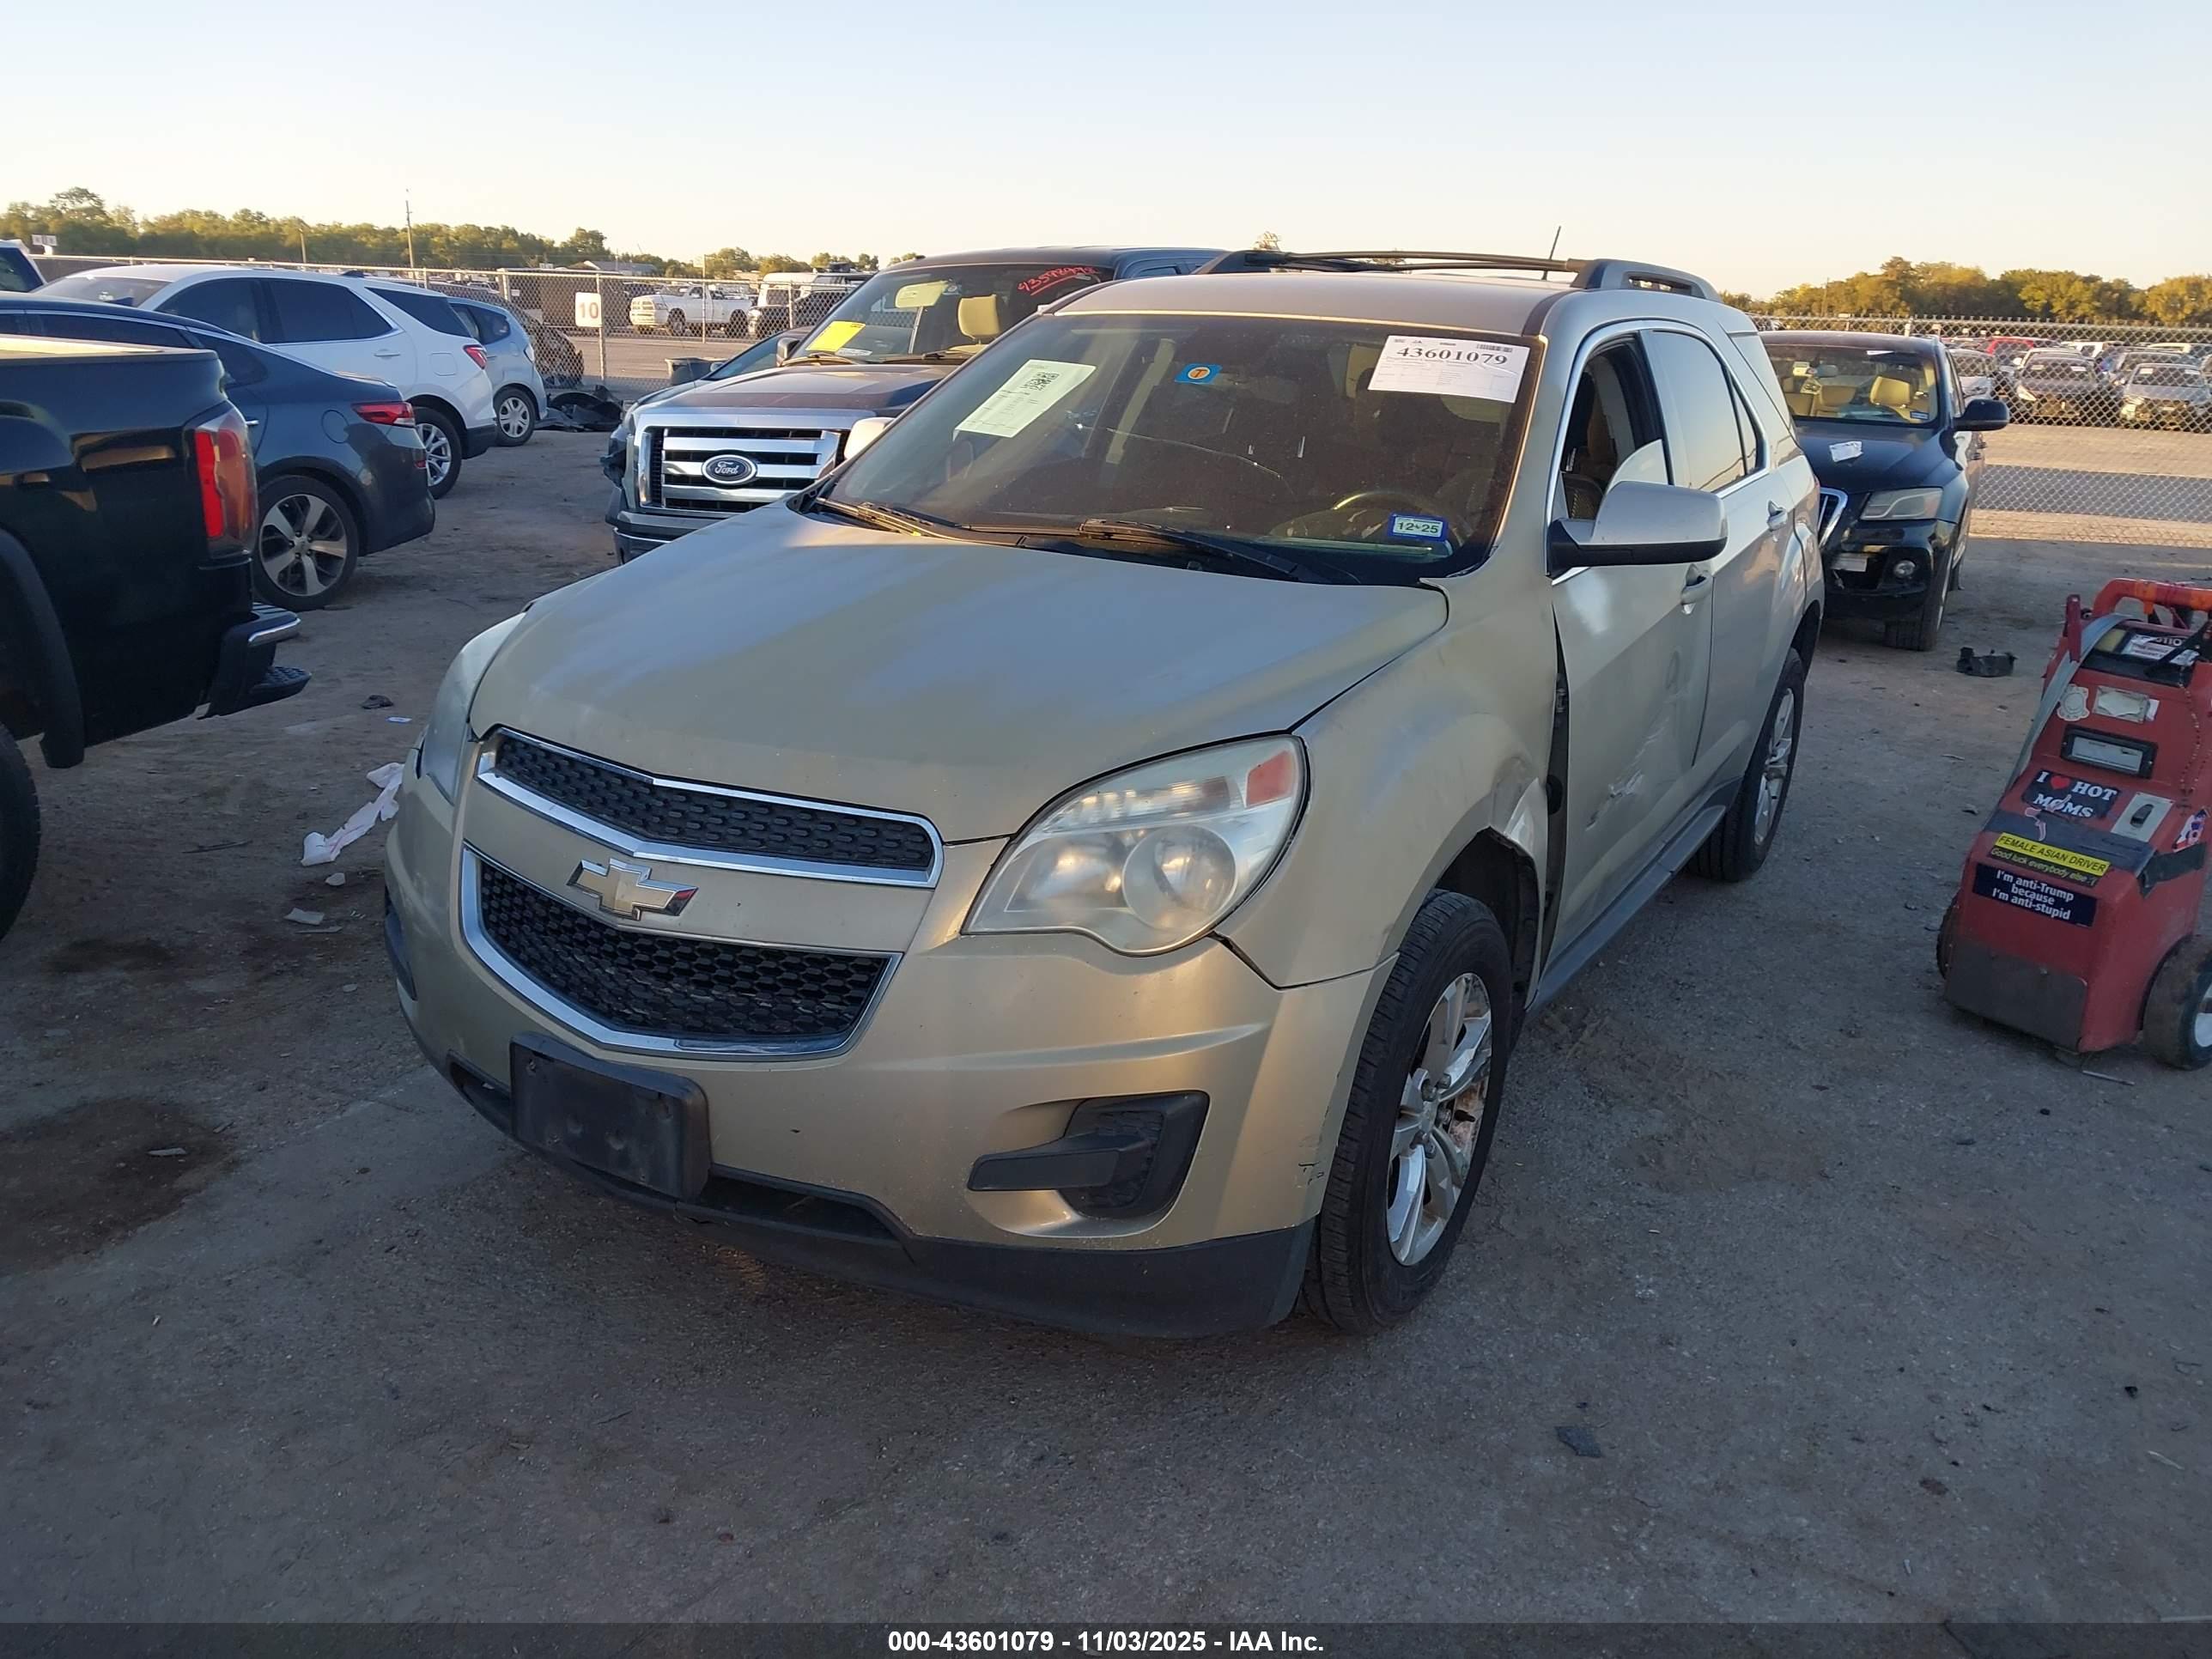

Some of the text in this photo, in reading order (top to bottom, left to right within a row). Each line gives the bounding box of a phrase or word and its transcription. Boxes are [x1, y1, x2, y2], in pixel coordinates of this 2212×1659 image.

[580, 301, 599, 319] 10
[1396, 347, 1508, 365] 43601079
[714, 460, 740, 475] Ford
[2037, 771, 2118, 800] I HOT
[2033, 793, 2094, 817] MOMS
[1990, 848, 2011, 860] Good
[2012, 854, 2027, 864] luck
[2028, 860, 2069, 878] everybody
[1998, 836, 2107, 872] FEMALE ASIAN DRIVER
[1996, 870, 2075, 902] I'm anti-Trump
[2011, 884, 2055, 905] because
[1992, 887, 2071, 921] I'm anti-stupid
